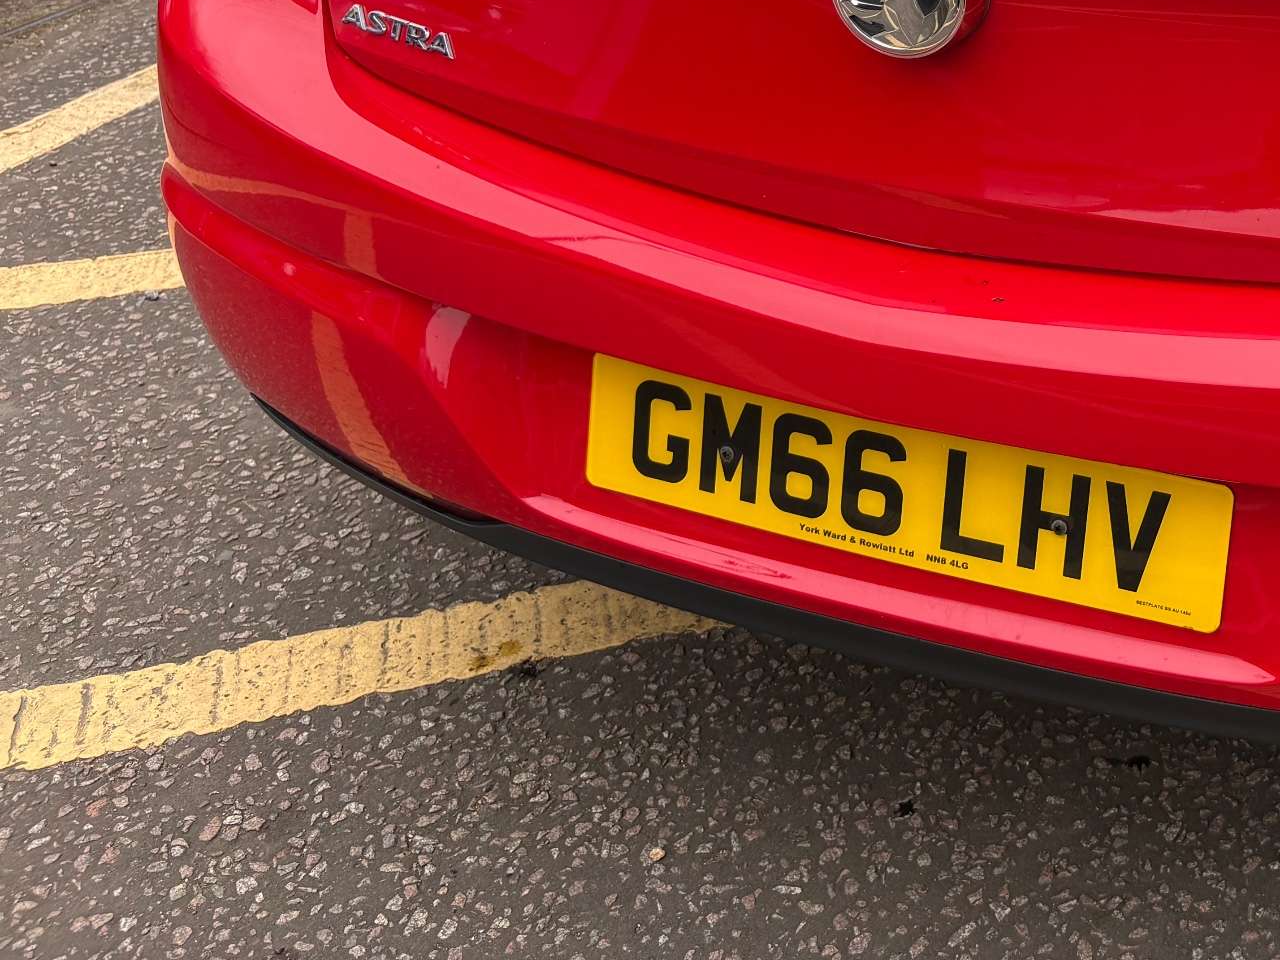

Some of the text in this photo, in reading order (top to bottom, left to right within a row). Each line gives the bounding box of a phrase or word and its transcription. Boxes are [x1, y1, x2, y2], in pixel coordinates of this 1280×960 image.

[340, 1, 456, 61] ASTRA
[631, 378, 1173, 593] GM66 LHV
[799, 522, 820, 535] York
[823, 529, 847, 542] Ward
[849, 535, 857, 544] &
[859, 537, 897, 554] Rowlatt
[899, 546, 915, 558] Ltd
[948, 558, 969, 570] 4LG
